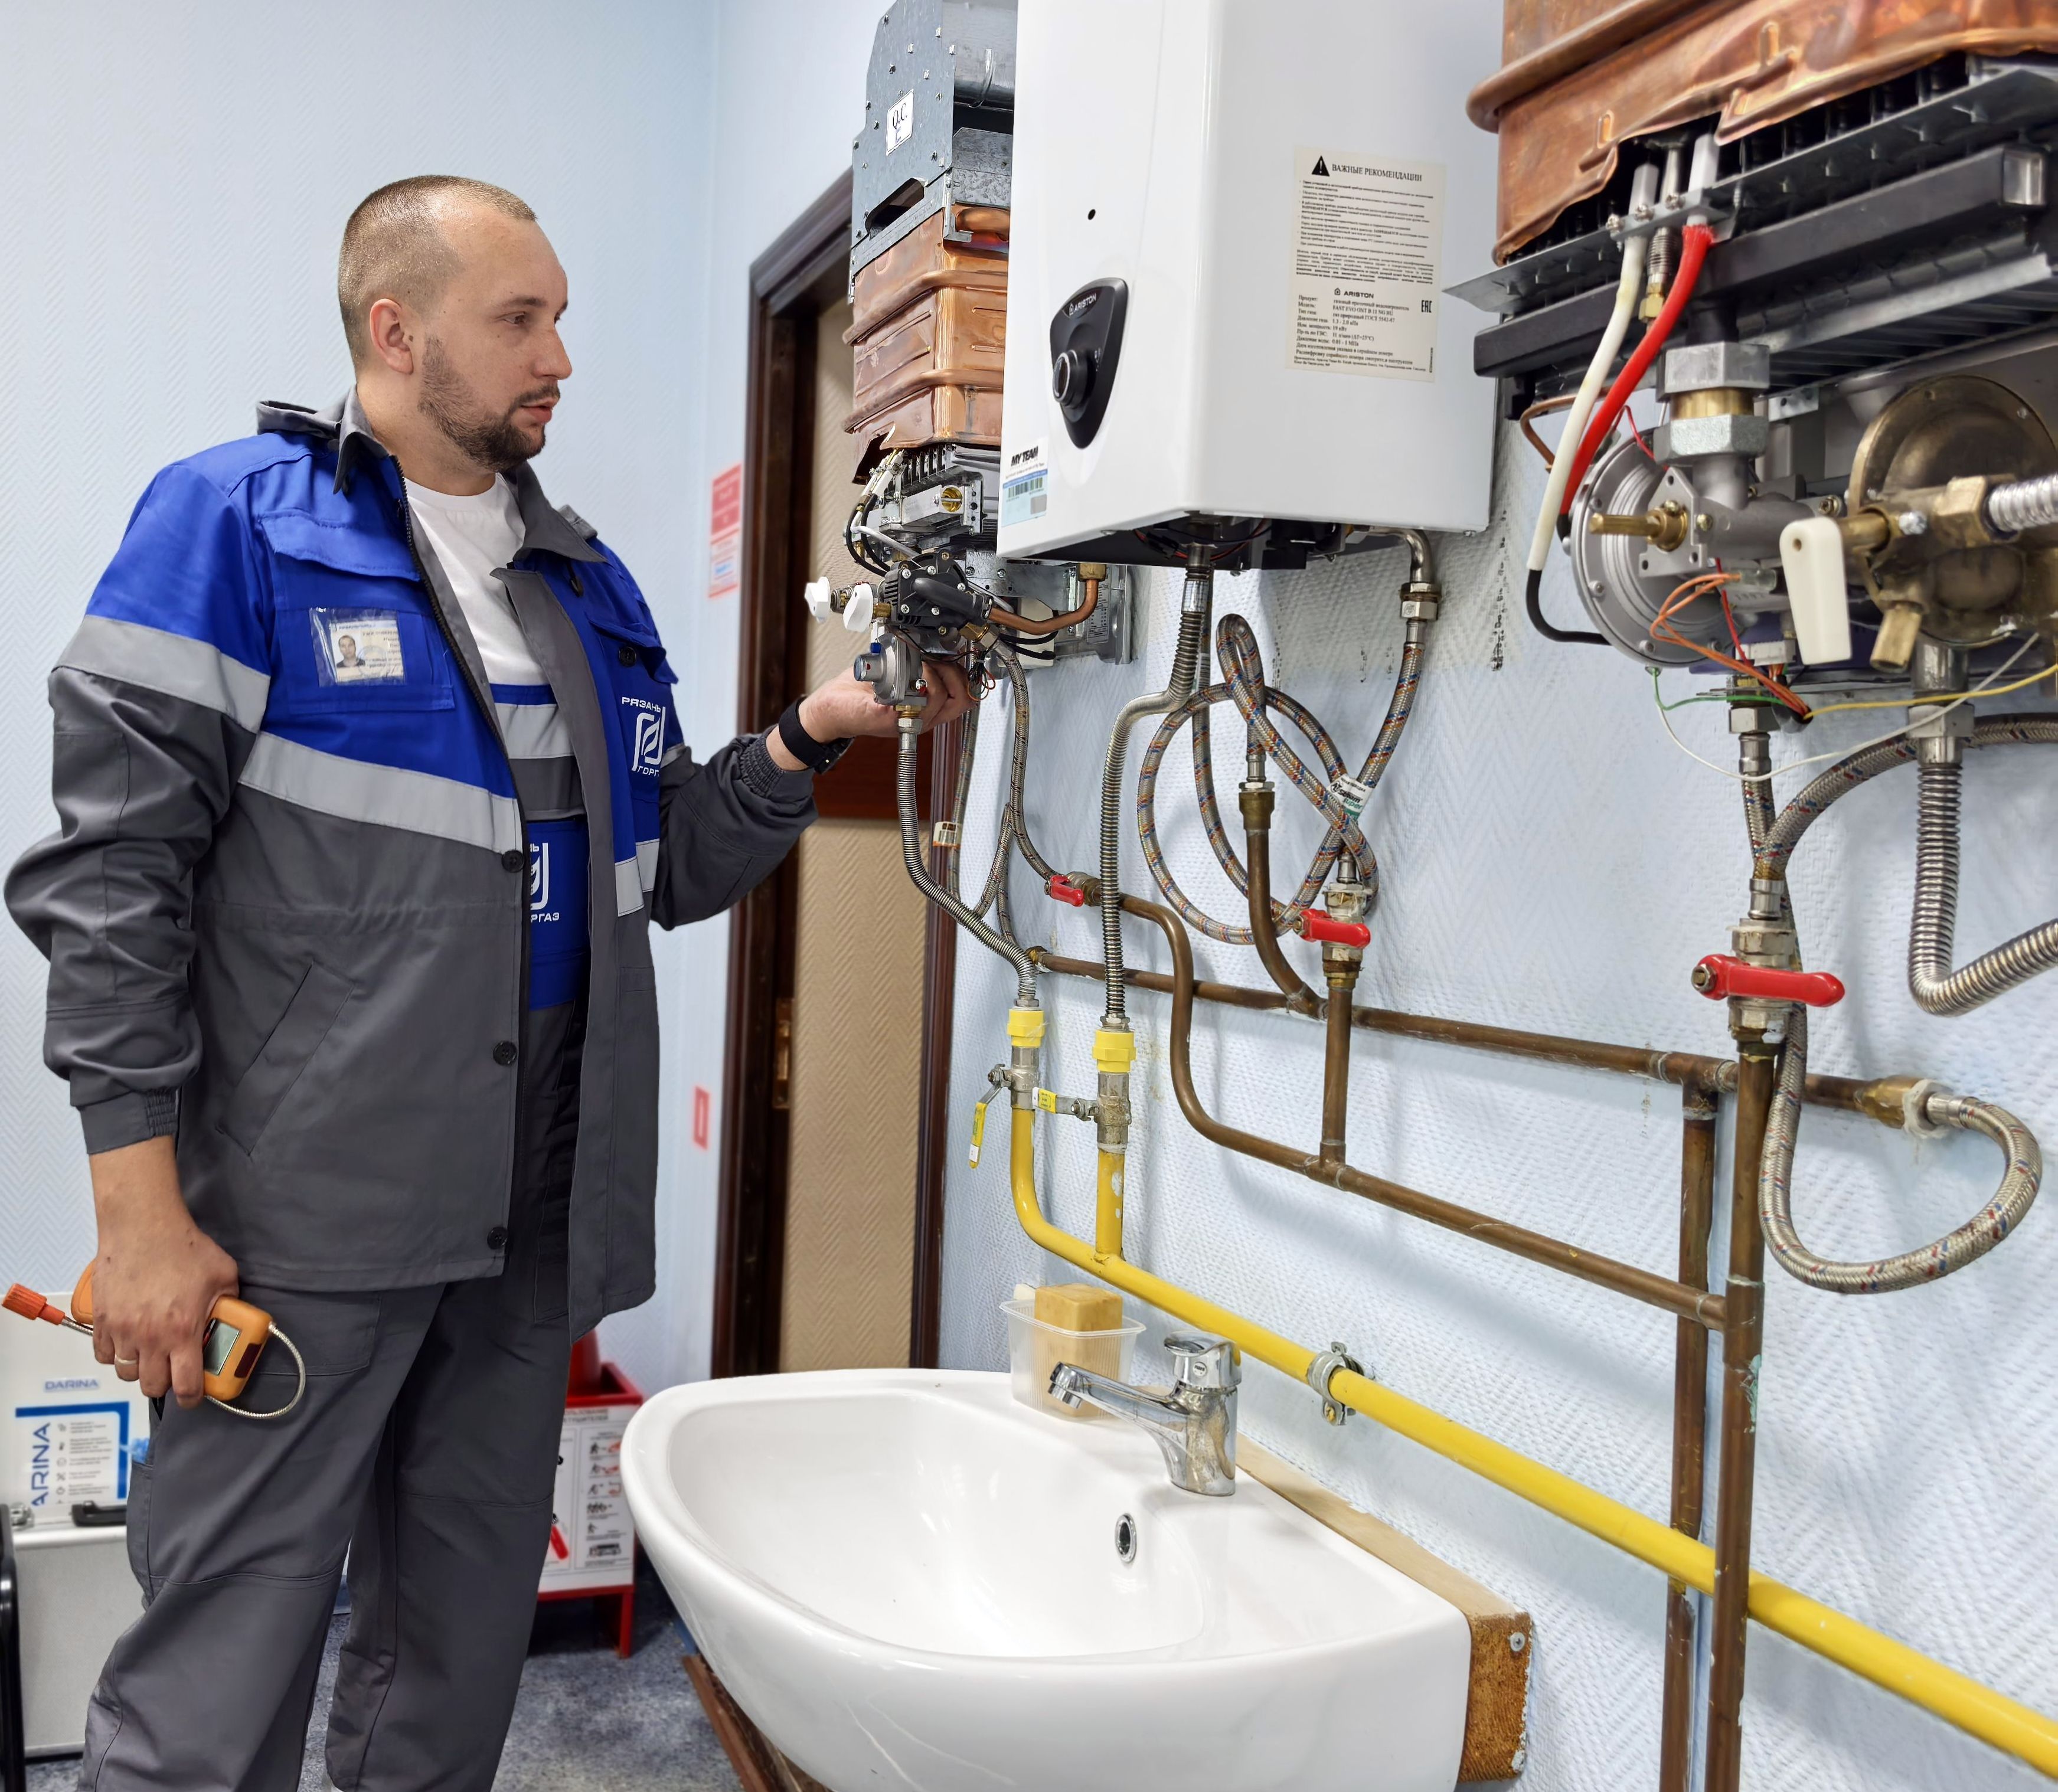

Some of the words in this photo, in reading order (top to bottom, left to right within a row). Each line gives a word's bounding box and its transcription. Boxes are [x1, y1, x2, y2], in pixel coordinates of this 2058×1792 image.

[1332, 163, 1363, 175] ВАЖНЫЕ
[1364, 168, 1422, 181] РЕКОМЕНДАЦИИ
[1074, 293, 1096, 313] ARISTON
[1011, 453, 1021, 466] MY
[1022, 446, 1038, 462] TEAM
[622, 696, 661, 712] РЯЗАНЬ
[638, 766, 659, 777] ГОРГ
[45, 1379, 99, 1391] DARINA
